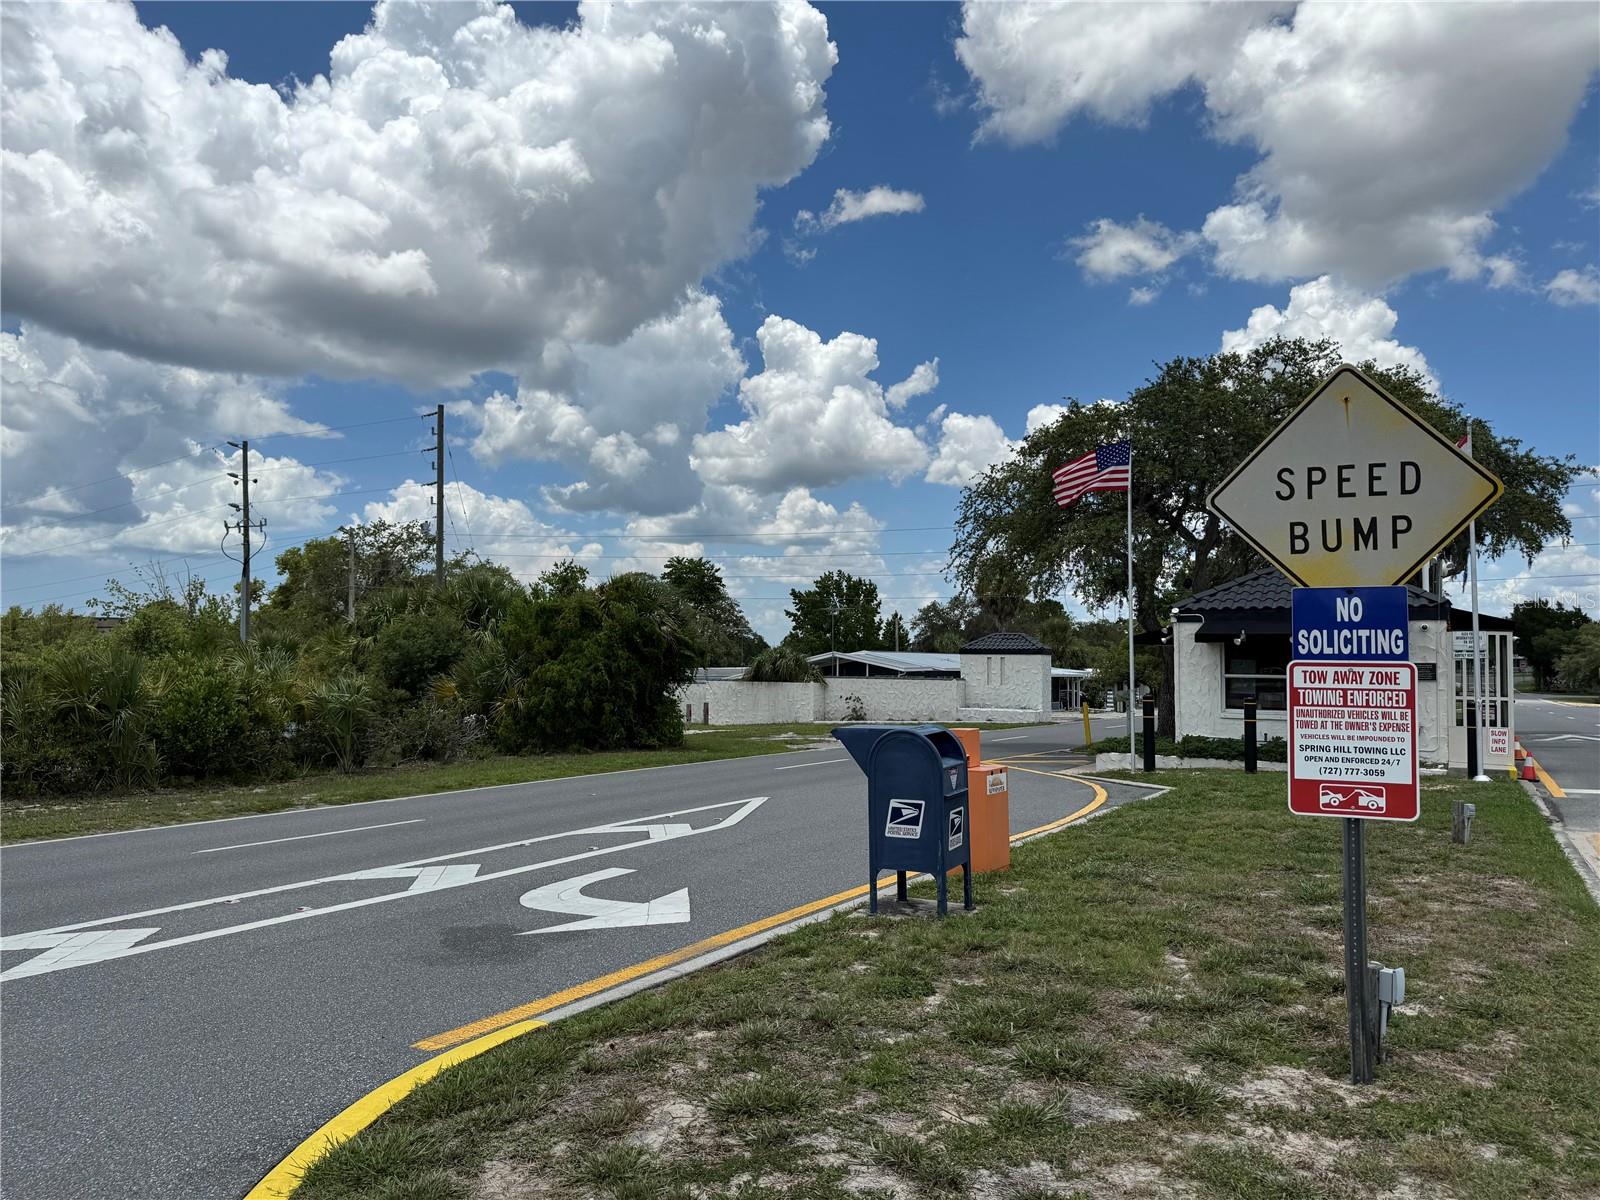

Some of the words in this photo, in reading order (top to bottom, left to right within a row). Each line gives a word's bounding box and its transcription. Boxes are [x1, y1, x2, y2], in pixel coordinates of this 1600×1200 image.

[1275, 461, 1422, 500] SPEED
[1290, 515, 1412, 554] BUMP
[1336, 597, 1362, 622] NO
[1298, 629, 1404, 654] SOLICITING
[1302, 670, 1328, 684] TOW
[1332, 671, 1364, 685] AWAY
[1369, 671, 1400, 686] ZONE
[1298, 689, 1344, 706] TOWING
[1348, 690, 1406, 707] ENFORCED
[1296, 709, 1345, 718] UNAUTHORIZED
[1347, 710, 1379, 720] VEHICLES
[1381, 711, 1398, 720] WILL
[1400, 712, 1408, 721] BE
[1296, 720, 1318, 729] TOWED
[1320, 721, 1328, 730] AT
[1330, 721, 1343, 730] THE
[1345, 721, 1376, 731] OWNER'S
[1379, 722, 1410, 732] EXPENSE
[1299, 744, 1330, 752] SPRING
[1353, 746, 1388, 755] TOWING
[1319, 767, 1342, 776] (727)
[1344, 768, 1385, 776] 777-3059
